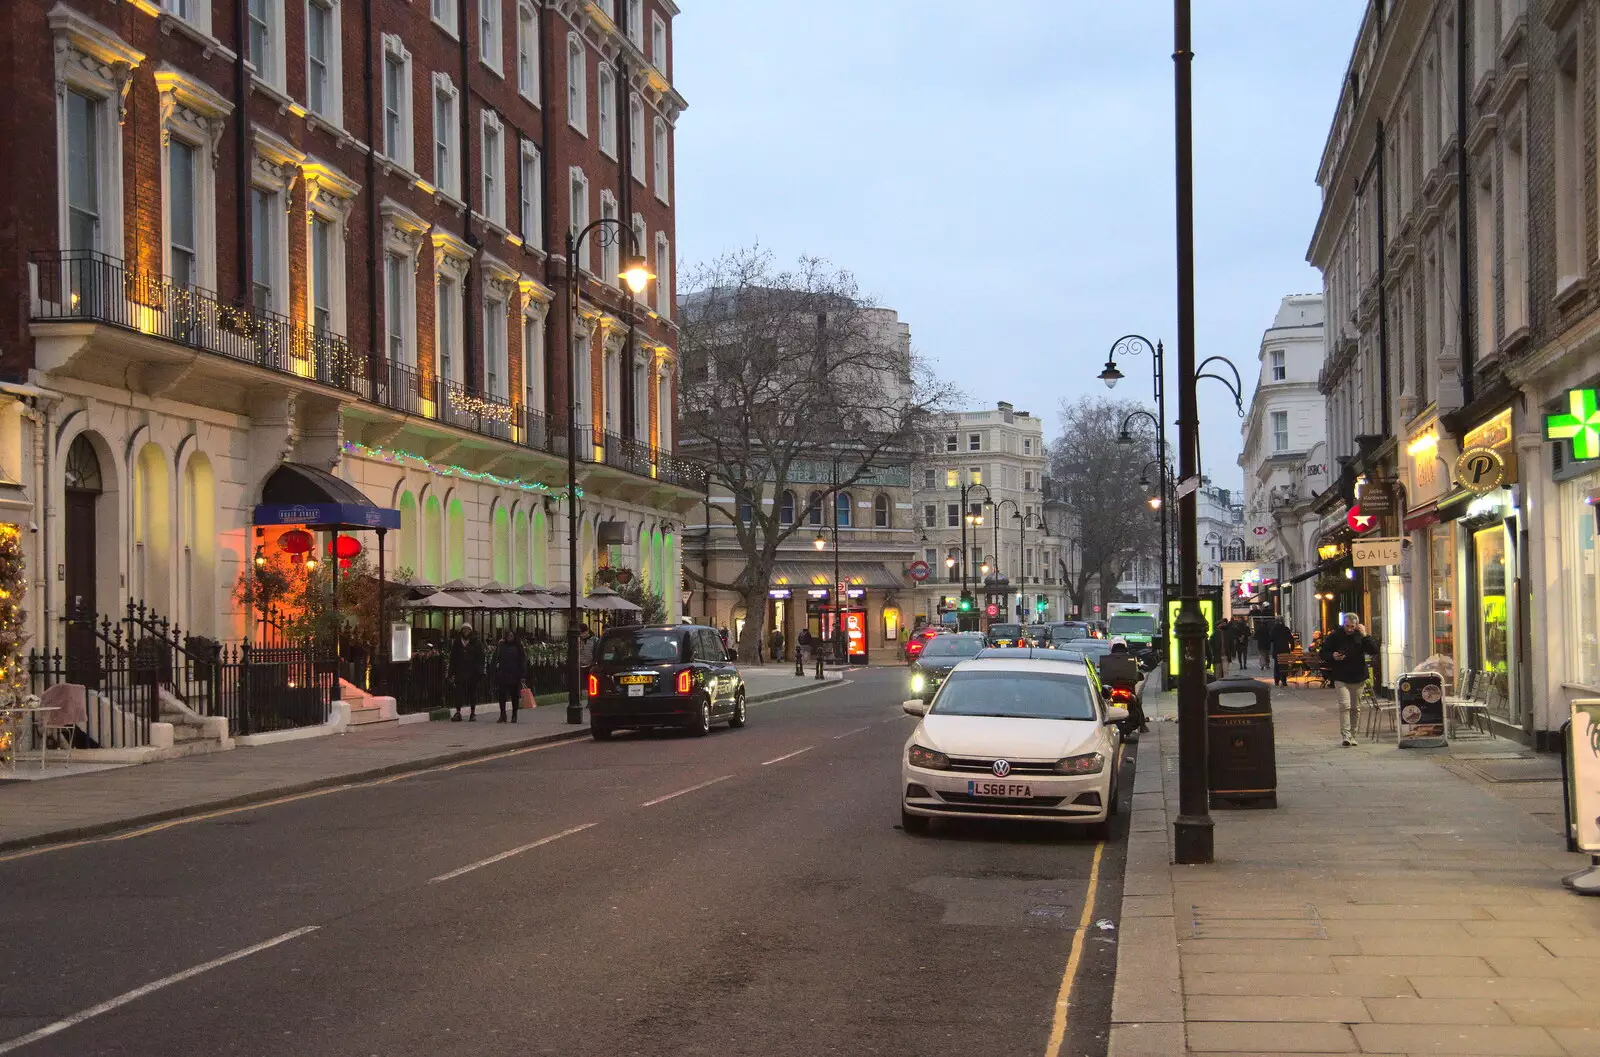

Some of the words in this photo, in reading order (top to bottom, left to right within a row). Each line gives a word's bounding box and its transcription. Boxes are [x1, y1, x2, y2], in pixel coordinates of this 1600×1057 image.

[1467, 455, 1494, 484] P
[1356, 549, 1398, 560] GAIL's
[975, 783, 1006, 795] LS68
[1008, 785, 1031, 797] FFA
